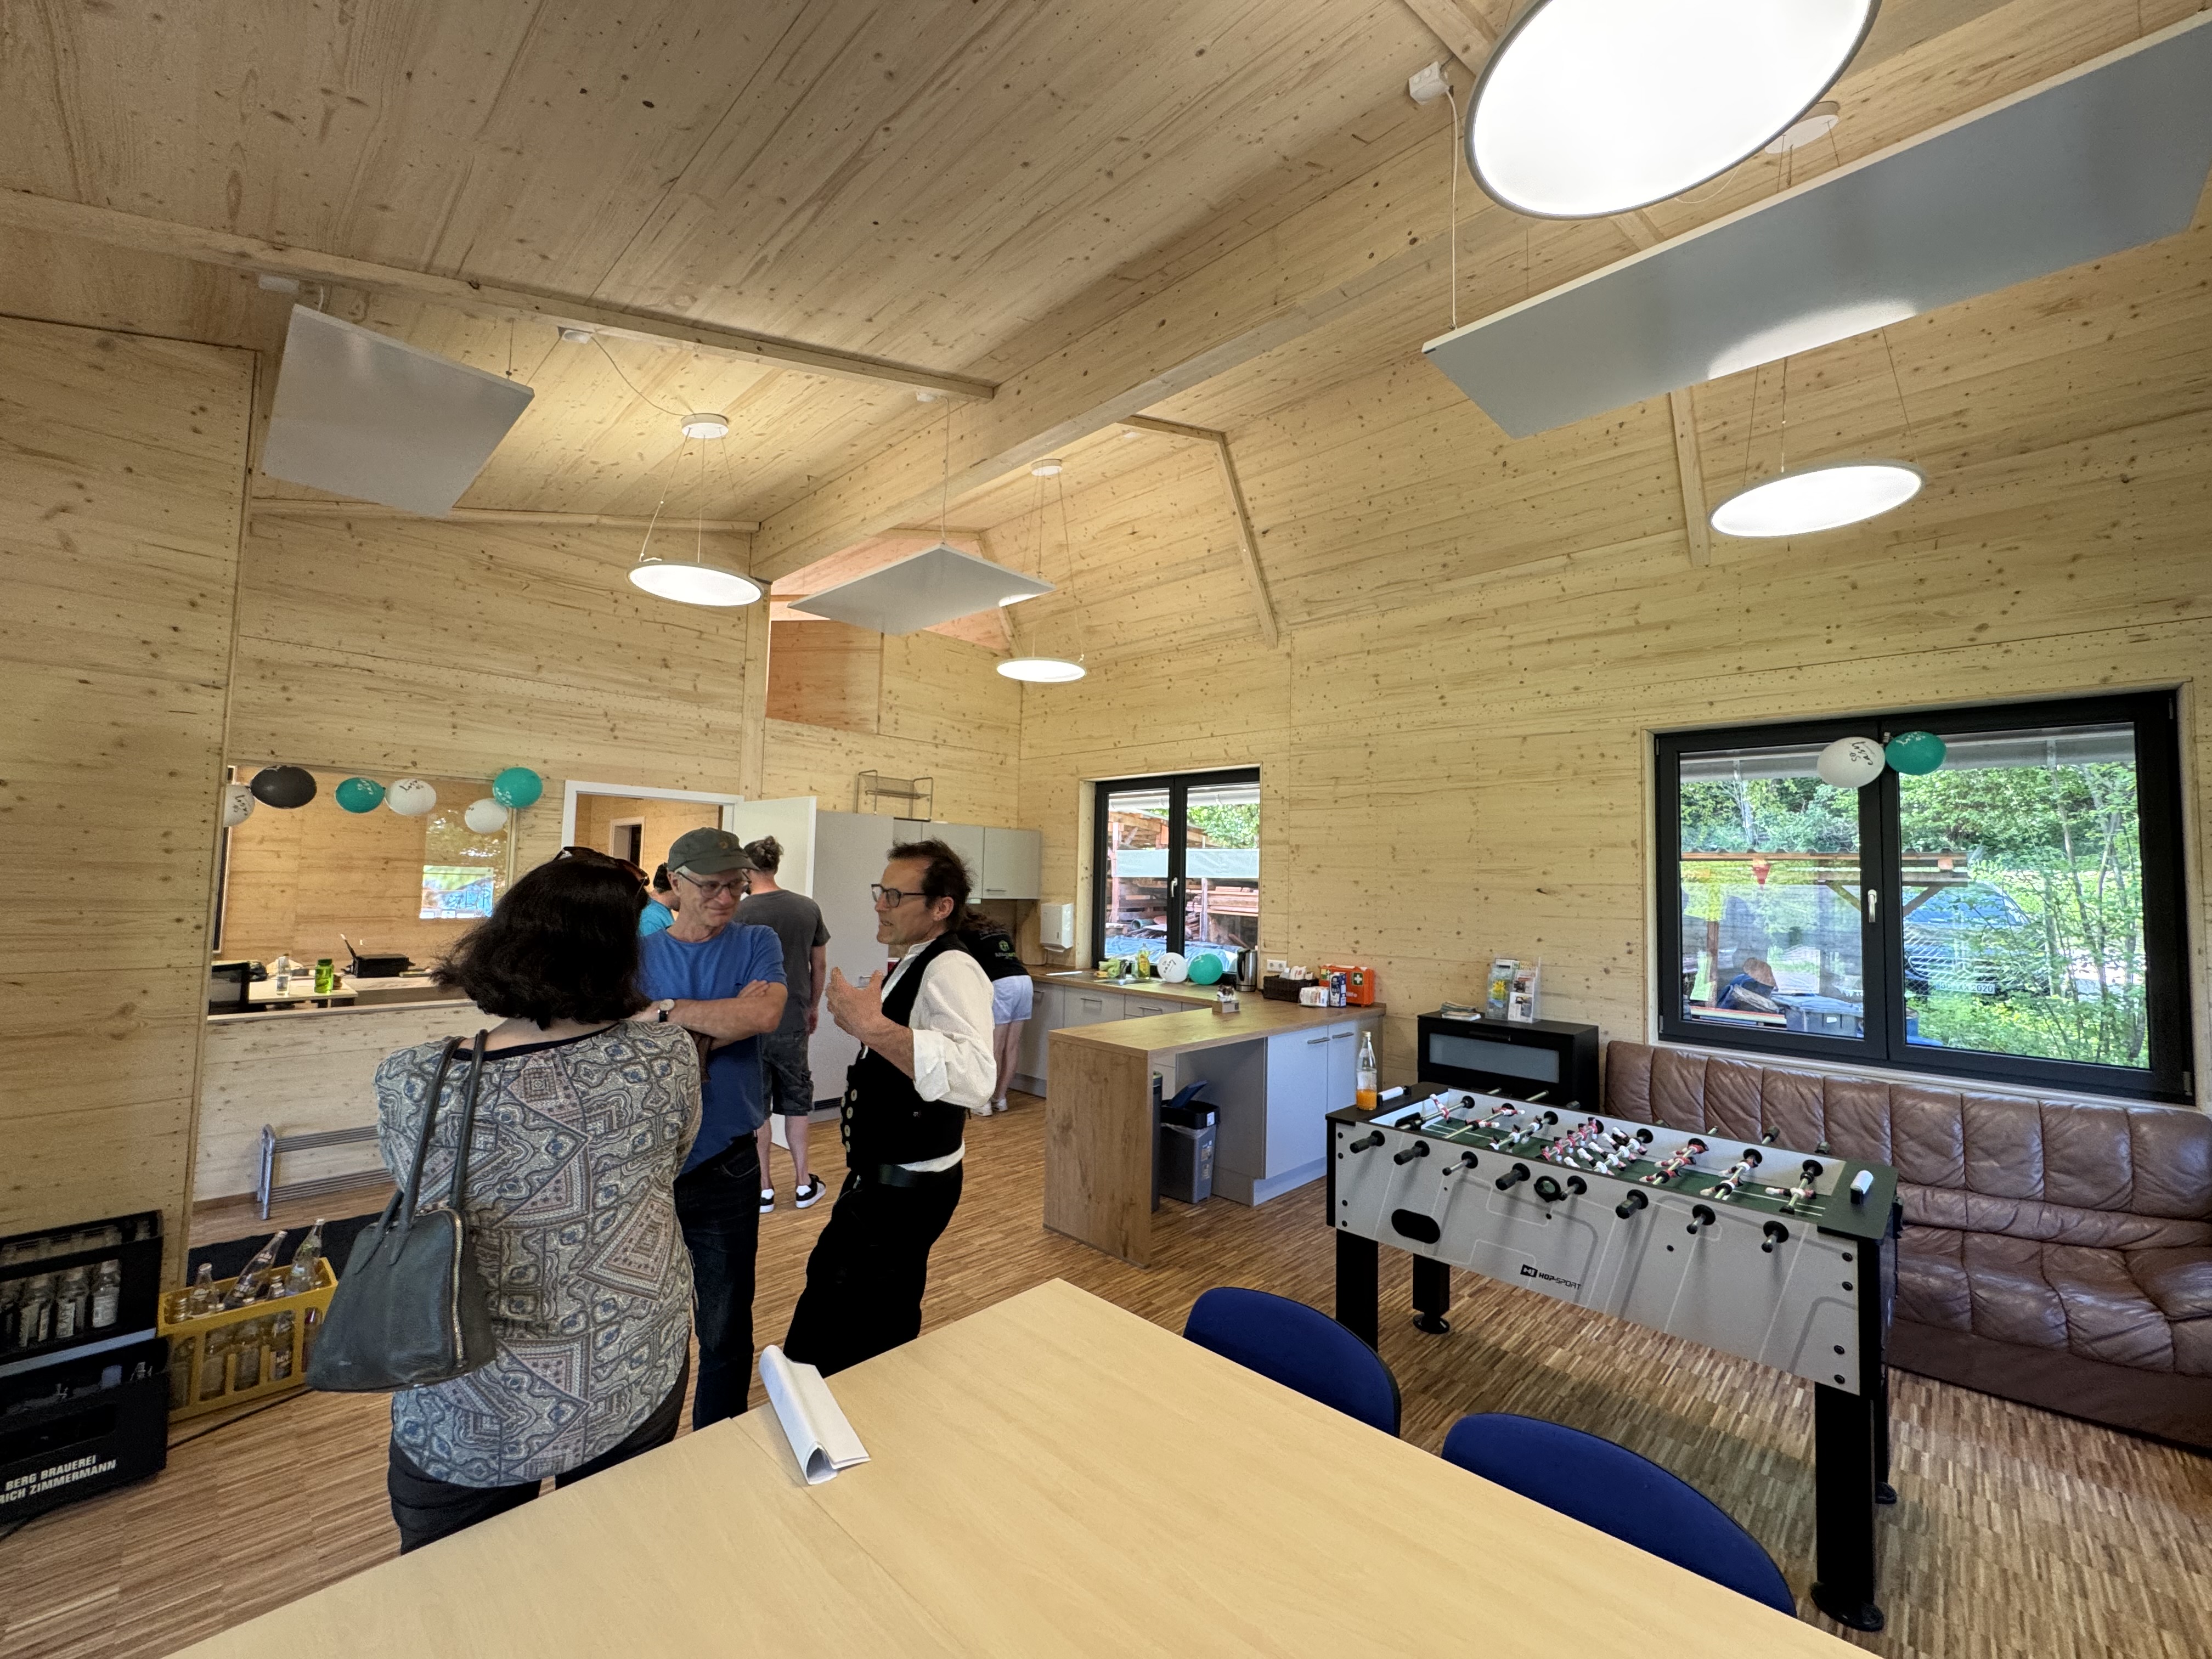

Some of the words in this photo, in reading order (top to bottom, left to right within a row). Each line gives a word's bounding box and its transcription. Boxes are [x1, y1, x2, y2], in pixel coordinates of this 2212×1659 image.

[1852, 741, 1873, 765] easy
[1971, 984, 1994, 992] 2020
[1539, 1272, 1582, 1290] HOP-SPORT
[5, 1473, 37, 1492] BERG
[40, 1454, 97, 1480] BRAUEREI
[29, 1459, 117, 1495] ZIMMERMANN
